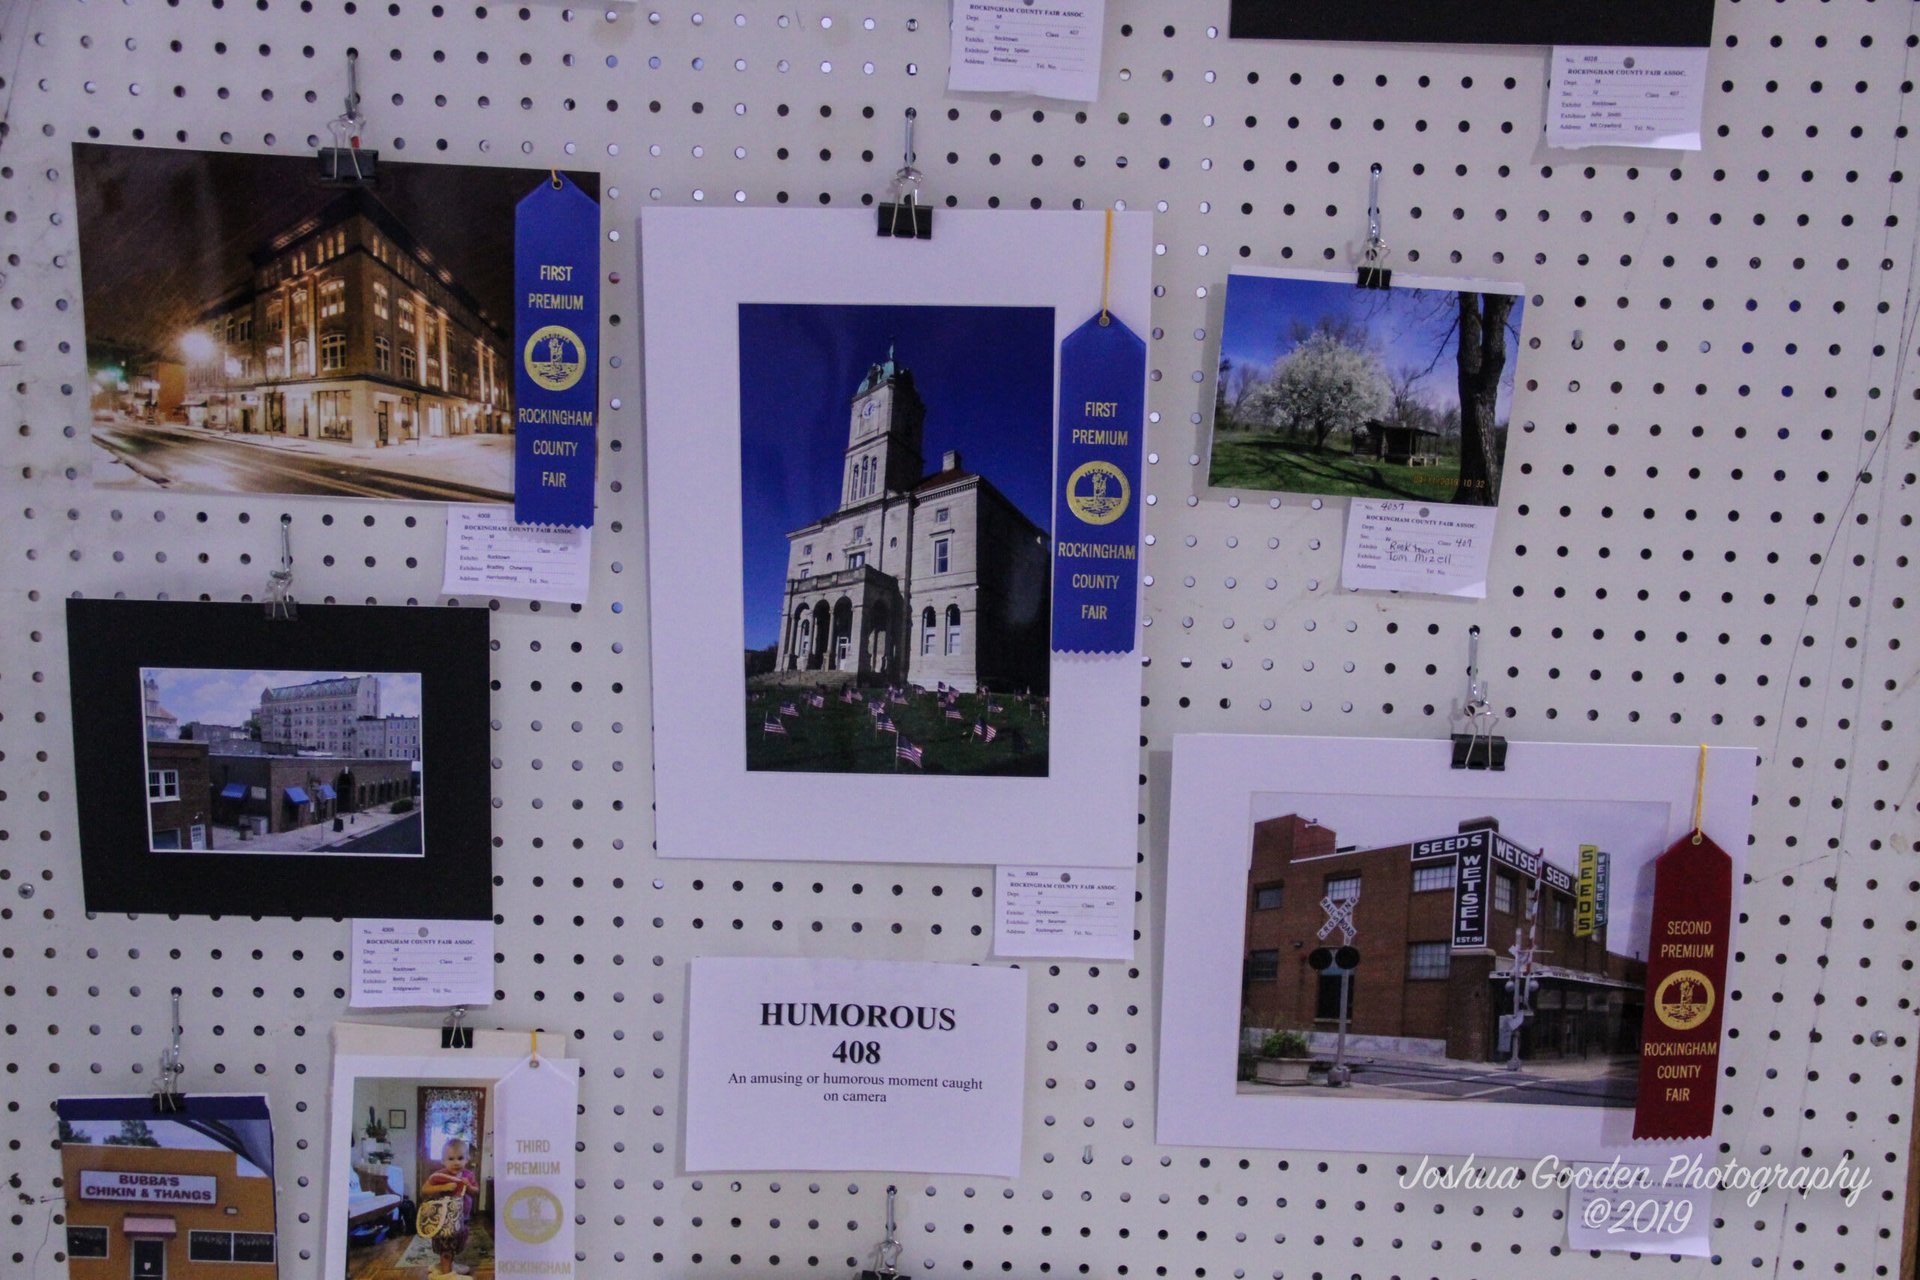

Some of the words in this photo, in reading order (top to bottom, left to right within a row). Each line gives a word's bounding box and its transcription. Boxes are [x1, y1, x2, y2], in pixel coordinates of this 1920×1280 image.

[970, 4, 1015, 13] ROCKINGHAM
[540, 265, 573, 281] FIRST
[528, 293, 584, 310] PREMIUM
[518, 407, 593, 426] ROCKINGHAM
[1085, 401, 1118, 418] FIRST
[1072, 429, 1129, 446] PREMIUM
[533, 439, 578, 457] COUNTY
[542, 471, 567, 487] FAIR
[1366, 514, 1410, 523] ROCKINGHAM
[1058, 542, 1136, 560] ROCKINGHAM
[1072, 573, 1120, 590] COUNTY
[1081, 605, 1108, 620] FAIR
[1419, 834, 1482, 855] SEEDS
[1545, 867, 1570, 890] SEED
[1460, 854, 1482, 931] WETSEL
[1578, 850, 1593, 931] SEEDS
[1667, 920, 1712, 936] SECOND
[1660, 943, 1714, 958] PREMIUM
[760, 1003, 956, 1031] HUMOROUS
[832, 1040, 881, 1064] 408
[1644, 1042, 1718, 1057] ROCKINGHAM
[1657, 1065, 1701, 1080] COUNTY
[728, 1073, 747, 1084] An
[750, 1072, 803, 1087] amusing
[806, 1075, 820, 1084] or
[823, 1073, 885, 1086] humorous
[888, 1076, 938, 1087] moment
[942, 1076, 983, 1091] caught
[823, 1093, 839, 1102] on
[842, 1092, 887, 1102] camera
[1666, 1088, 1690, 1102] FAIR
[516, 1139, 551, 1153] THIRD
[506, 1160, 561, 1176] PREMIUM
[119, 1174, 180, 1187] BUBBA'S
[85, 1186, 136, 1198] CHIKIN
[140, 1189, 149, 1198] &
[155, 1189, 212, 1201] THANGS
[497, 1261, 571, 1275] ROCKINGHAM
